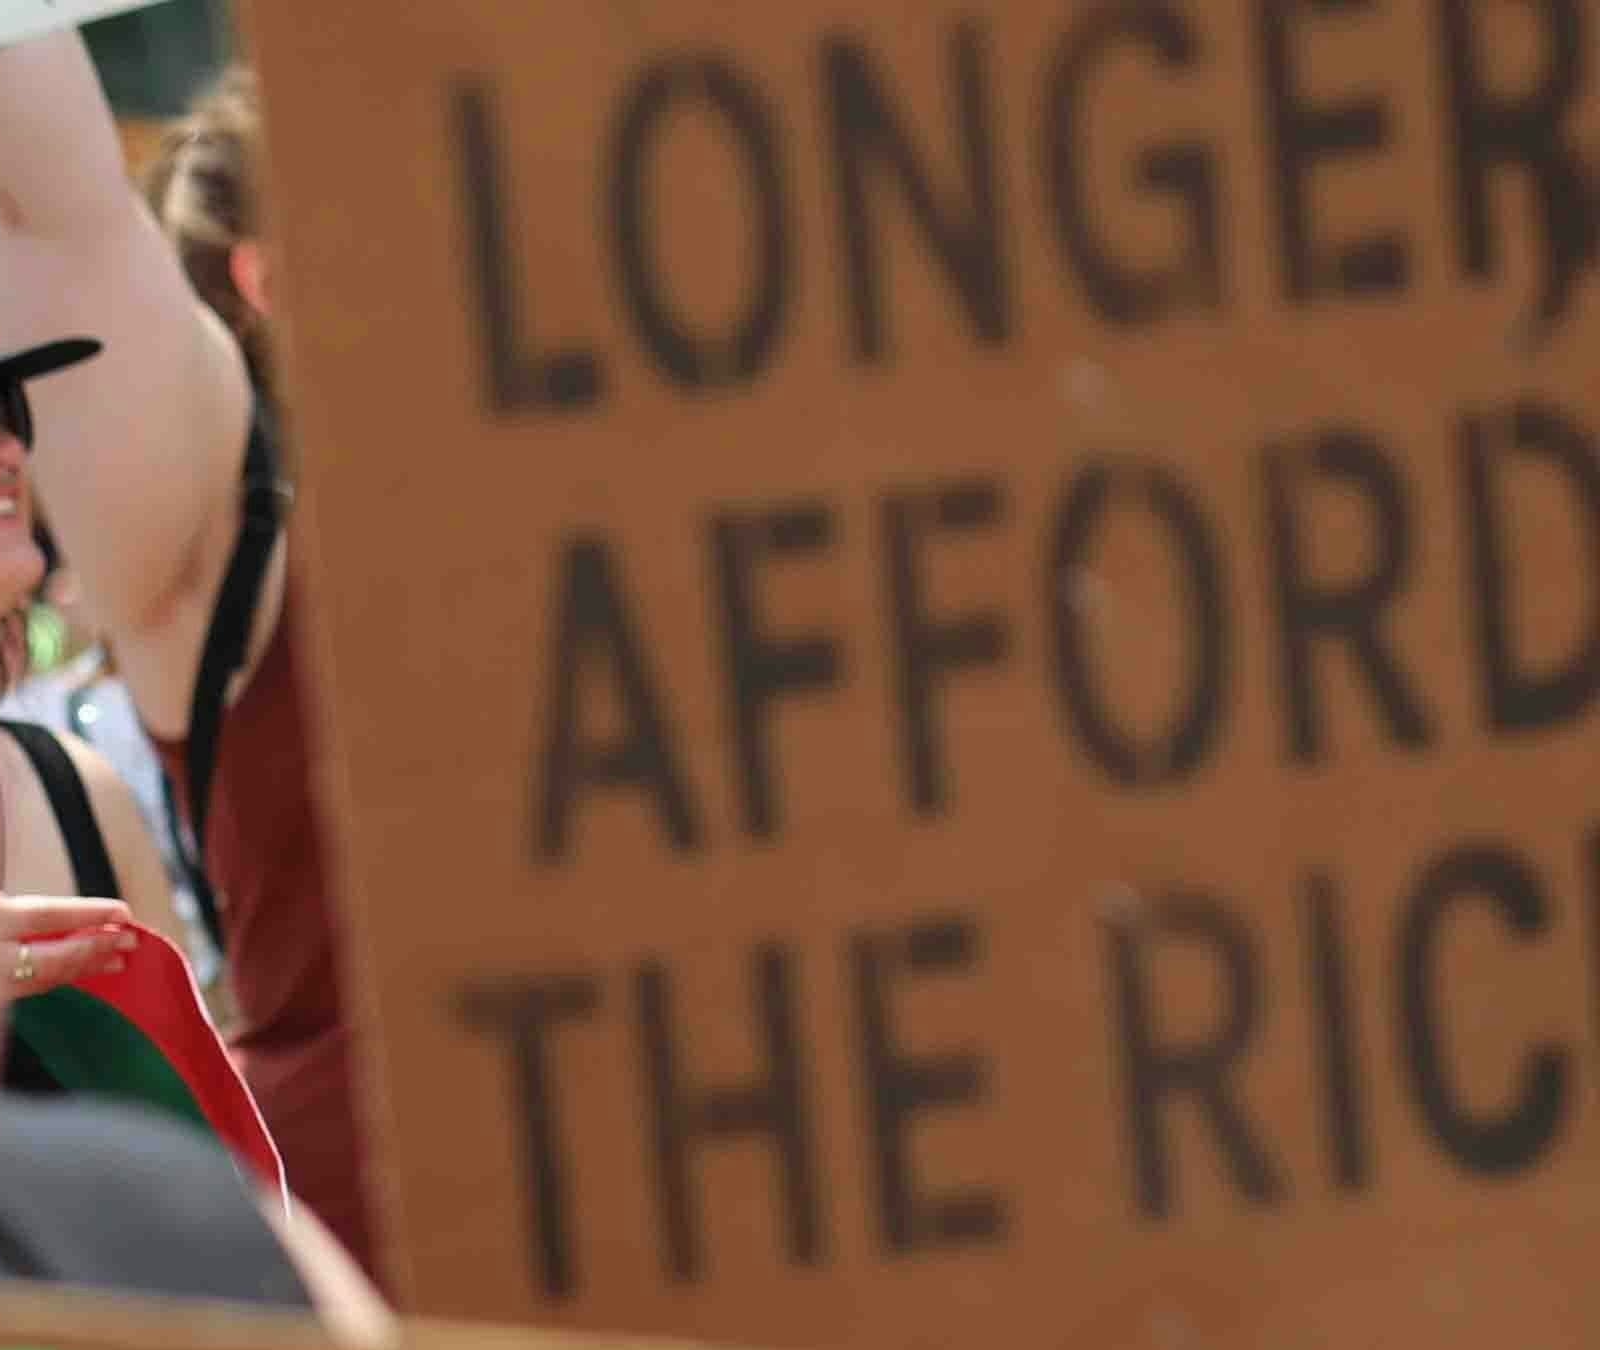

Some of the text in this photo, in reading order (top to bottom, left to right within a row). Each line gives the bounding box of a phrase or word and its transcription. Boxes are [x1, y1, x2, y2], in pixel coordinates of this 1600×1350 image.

[528, 398, 1600, 868] AFFORD
[450, 820, 1600, 1302] THE RIC
